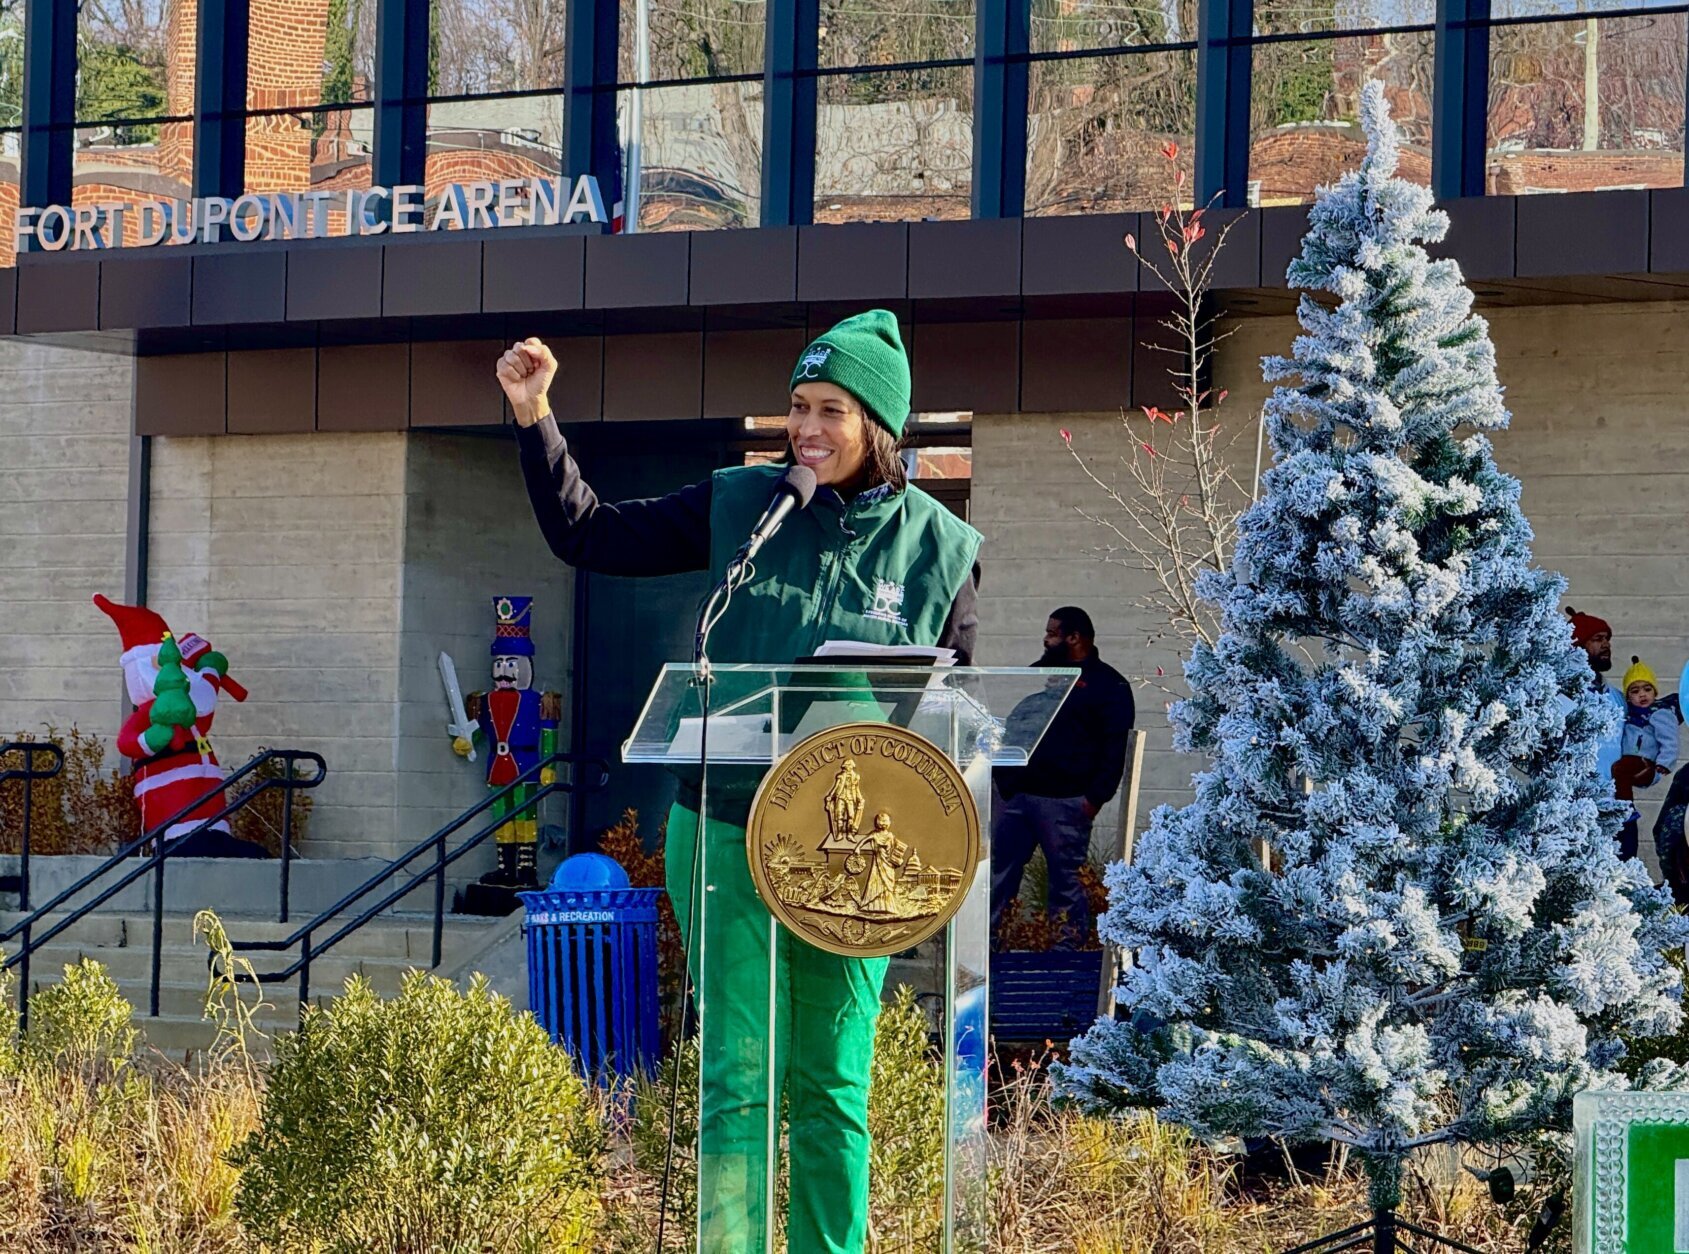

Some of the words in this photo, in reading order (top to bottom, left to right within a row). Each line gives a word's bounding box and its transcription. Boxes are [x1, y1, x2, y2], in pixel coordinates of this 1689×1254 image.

[14, 203, 128, 252] FORT
[138, 190, 335, 246] DUPONT
[345, 185, 419, 235] ICE
[431, 174, 604, 231] ARENA
[770, 738, 845, 810] DISTRICT
[850, 735, 877, 756] OF
[880, 736, 962, 817] COLUMBIA
[550, 912, 557, 922] &
[559, 910, 615, 922] RECREATION
